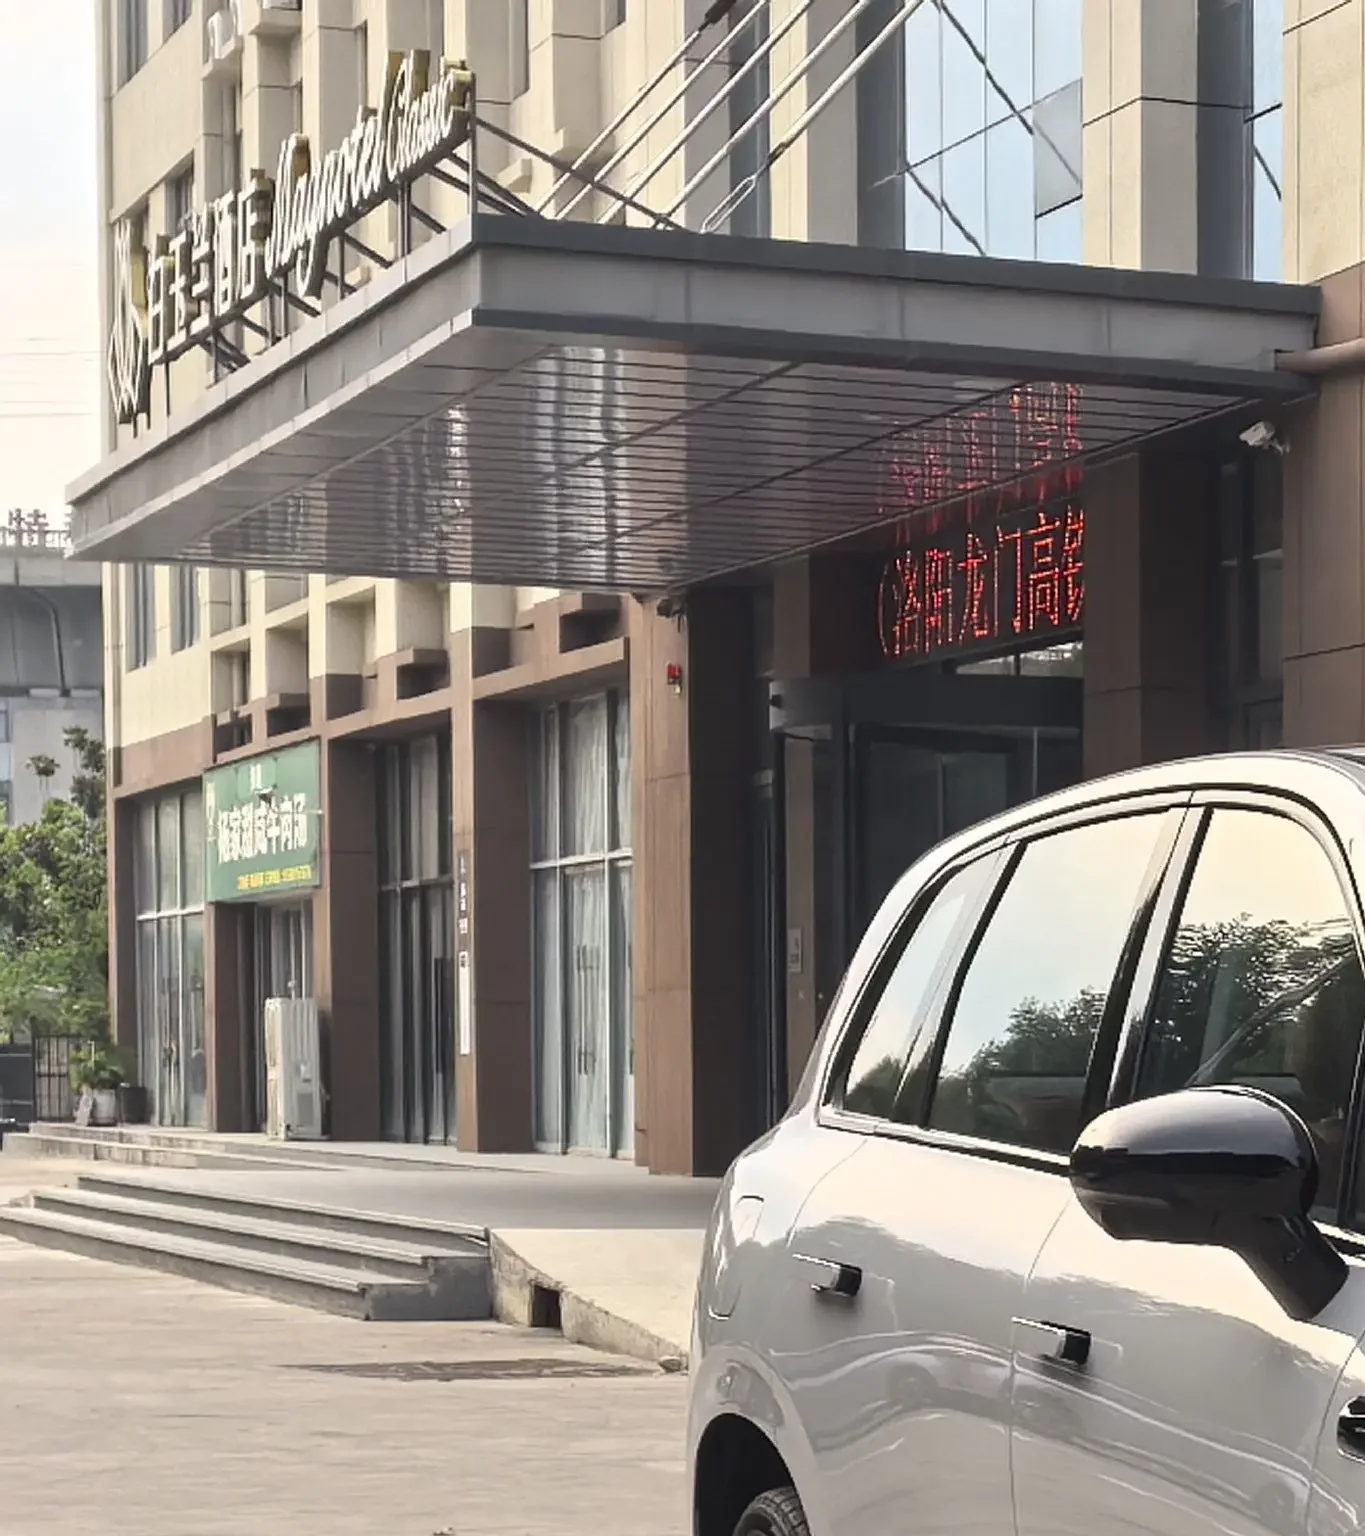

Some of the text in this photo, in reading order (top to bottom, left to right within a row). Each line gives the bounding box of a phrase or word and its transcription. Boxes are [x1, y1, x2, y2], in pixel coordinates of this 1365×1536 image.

[147, 183, 268, 364] 白玉兰酒店
